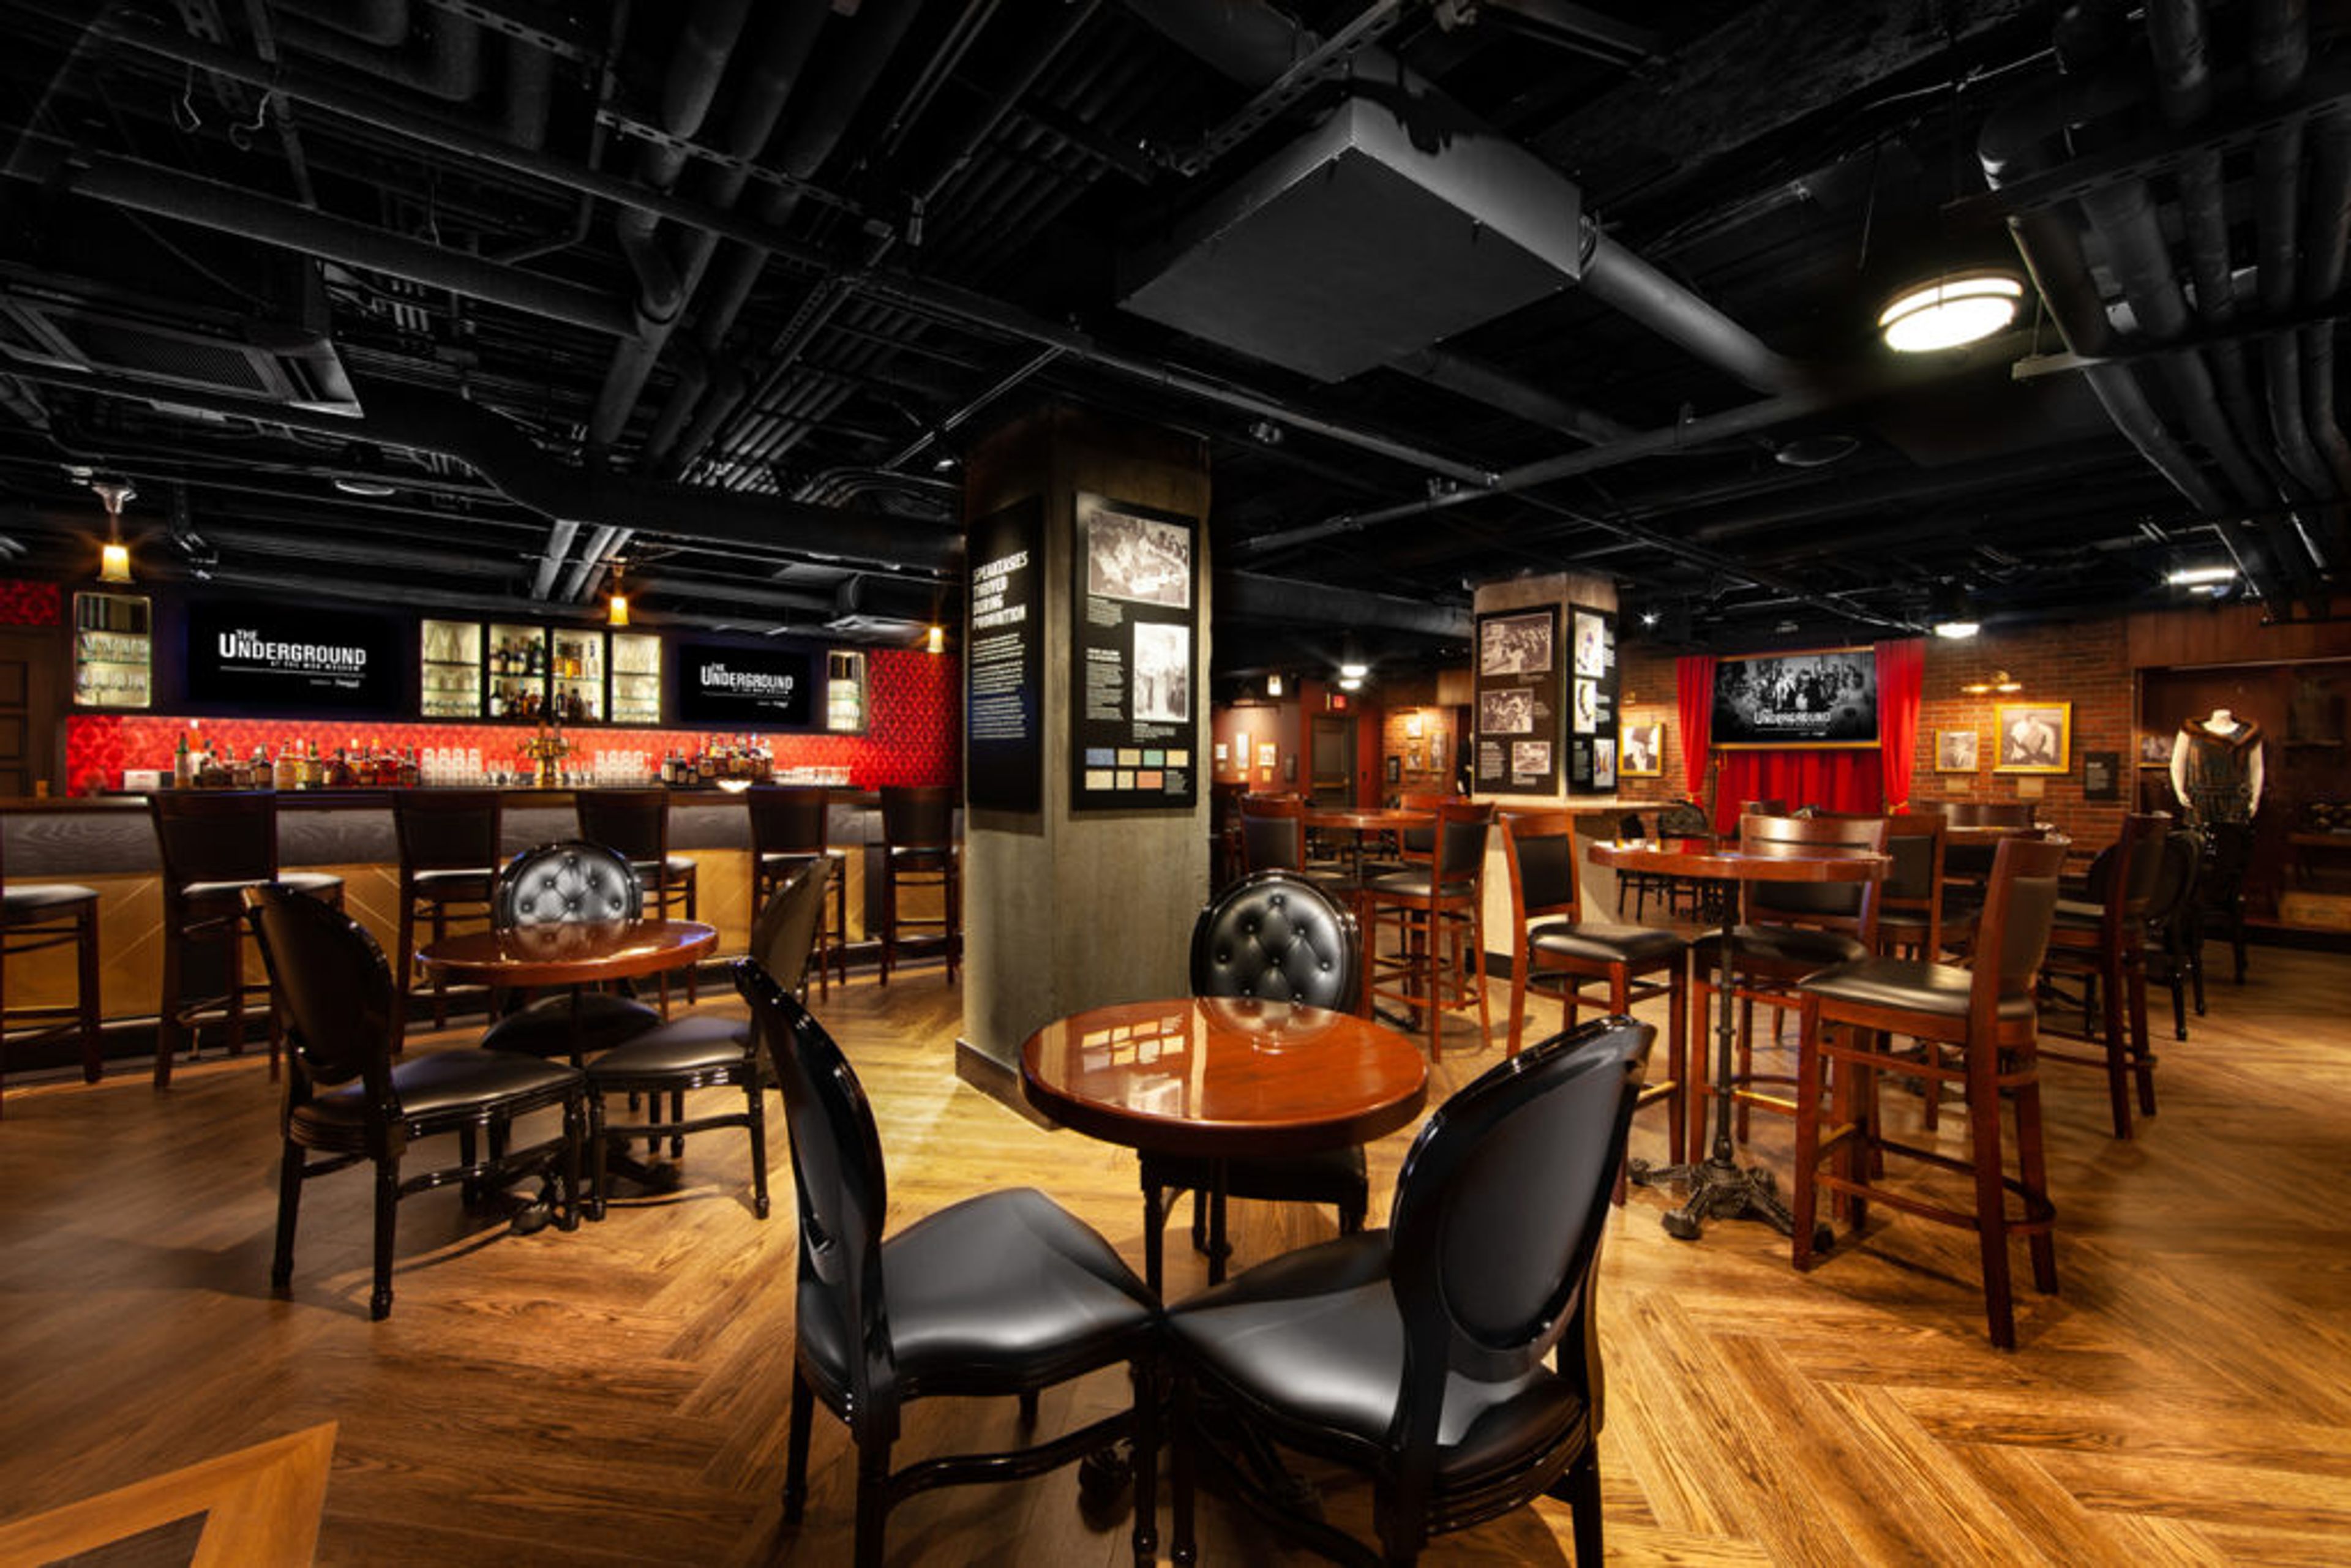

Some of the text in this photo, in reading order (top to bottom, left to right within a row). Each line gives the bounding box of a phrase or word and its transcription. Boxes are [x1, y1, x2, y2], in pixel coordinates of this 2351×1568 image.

[236, 629, 258, 641] THE
[219, 632, 366, 665] UNDERGROUND
[701, 666, 793, 689] UNDERGROUND
